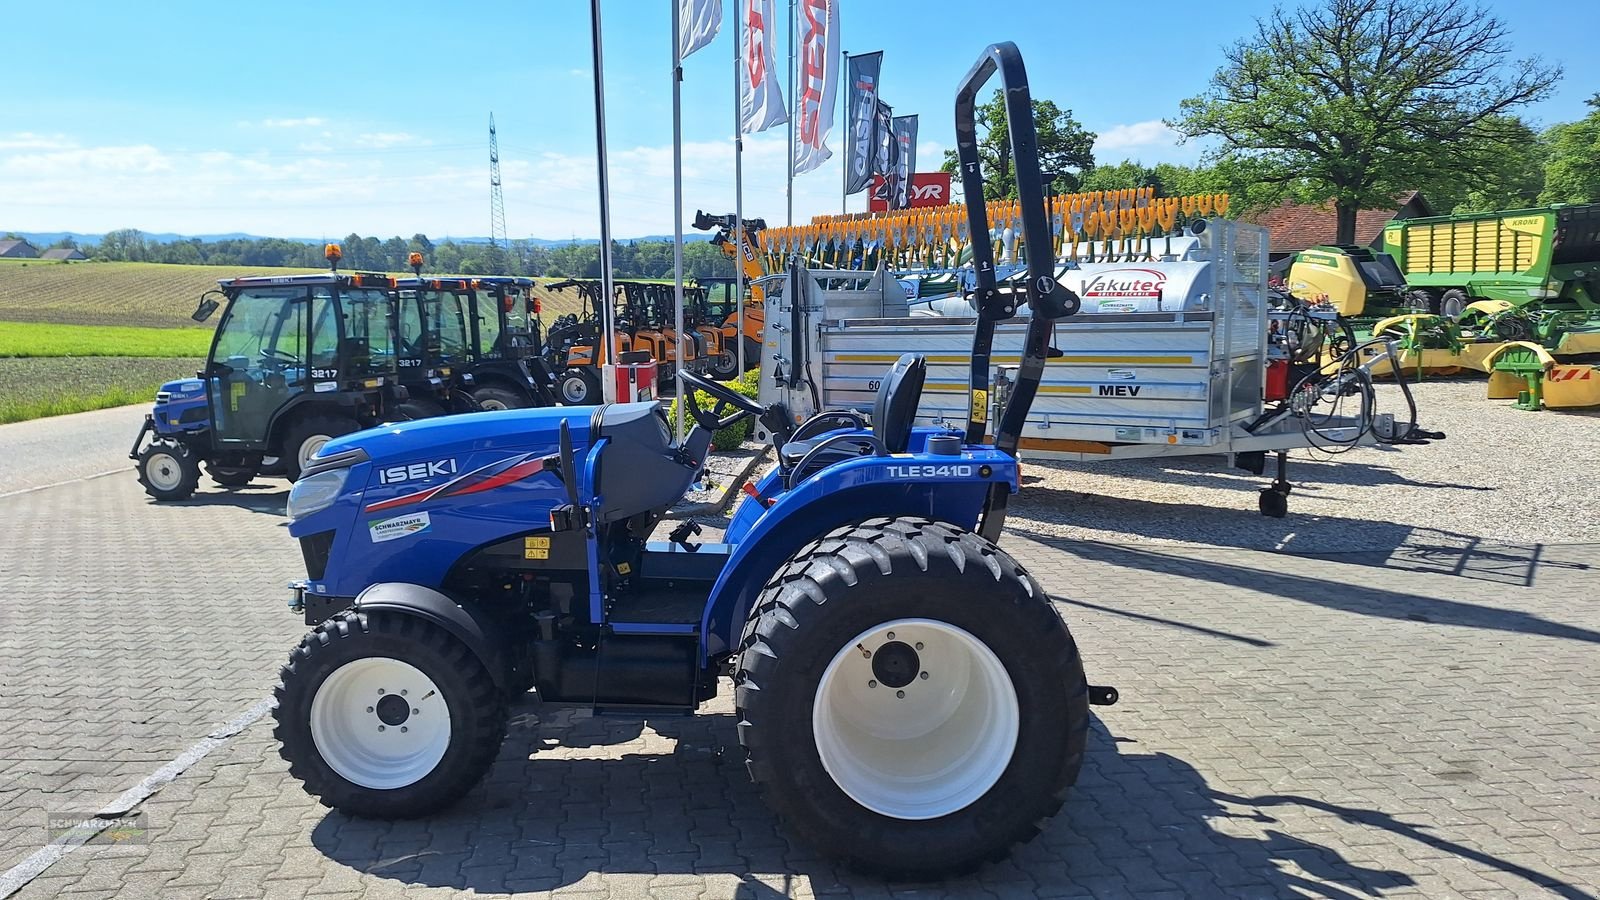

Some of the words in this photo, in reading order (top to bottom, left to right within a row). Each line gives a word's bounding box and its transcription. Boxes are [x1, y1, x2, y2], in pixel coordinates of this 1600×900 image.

[1512, 218, 1539, 227] KRONE
[1081, 276, 1166, 297] Vakutec
[399, 359, 422, 367] 3217
[311, 369, 338, 378] 3217
[1099, 385, 1141, 396] MEV
[379, 458, 457, 484] ISEKI
[374, 518, 421, 531] SCHWARZMAYR
